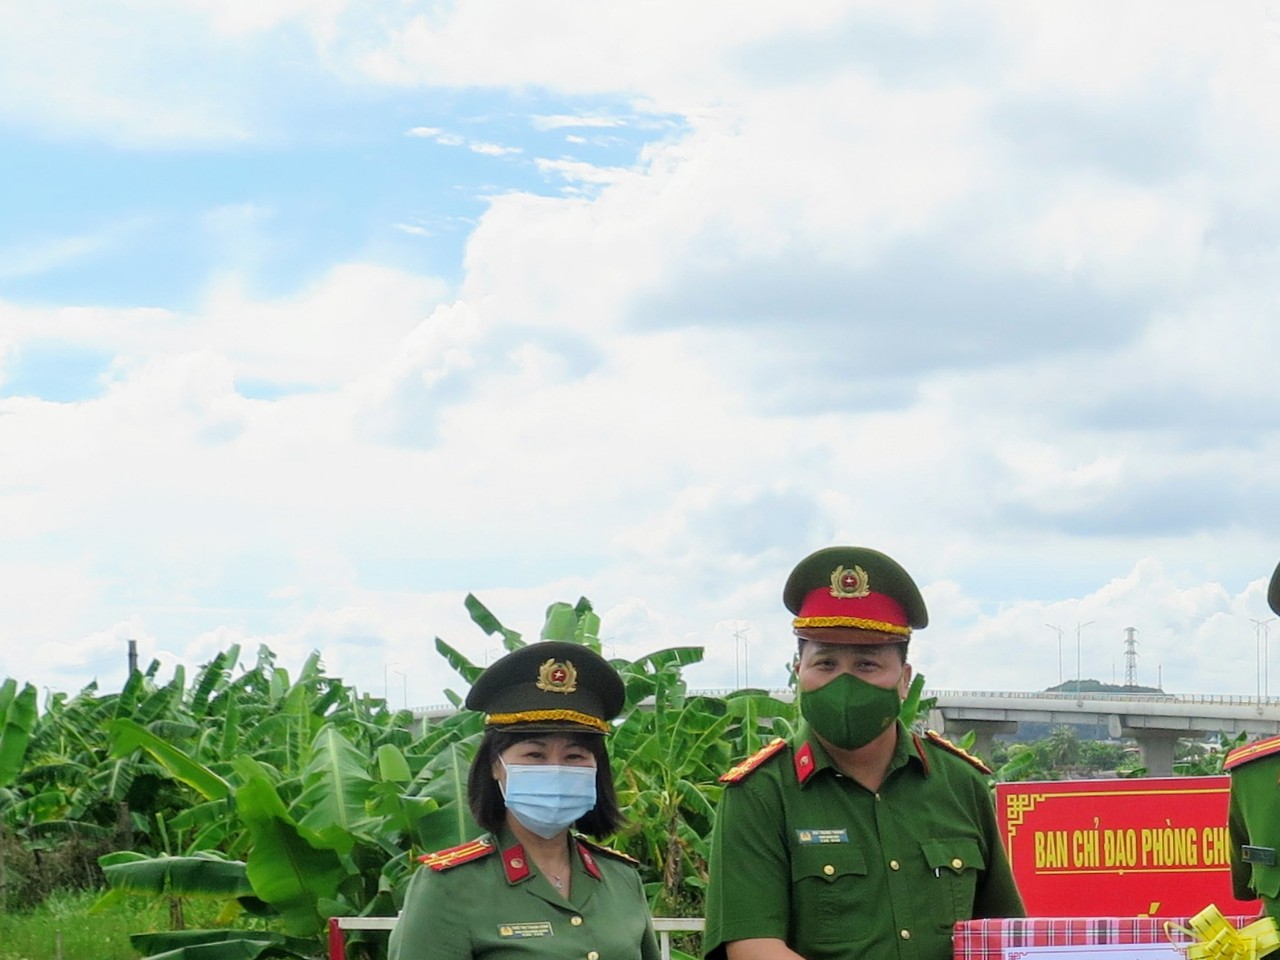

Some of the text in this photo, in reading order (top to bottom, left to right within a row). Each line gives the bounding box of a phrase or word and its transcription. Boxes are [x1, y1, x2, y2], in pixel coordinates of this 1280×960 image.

[1035, 831, 1068, 868] BAN
[1073, 817, 1099, 867] CHỈ
[1141, 819, 1197, 867] PHÒNG
